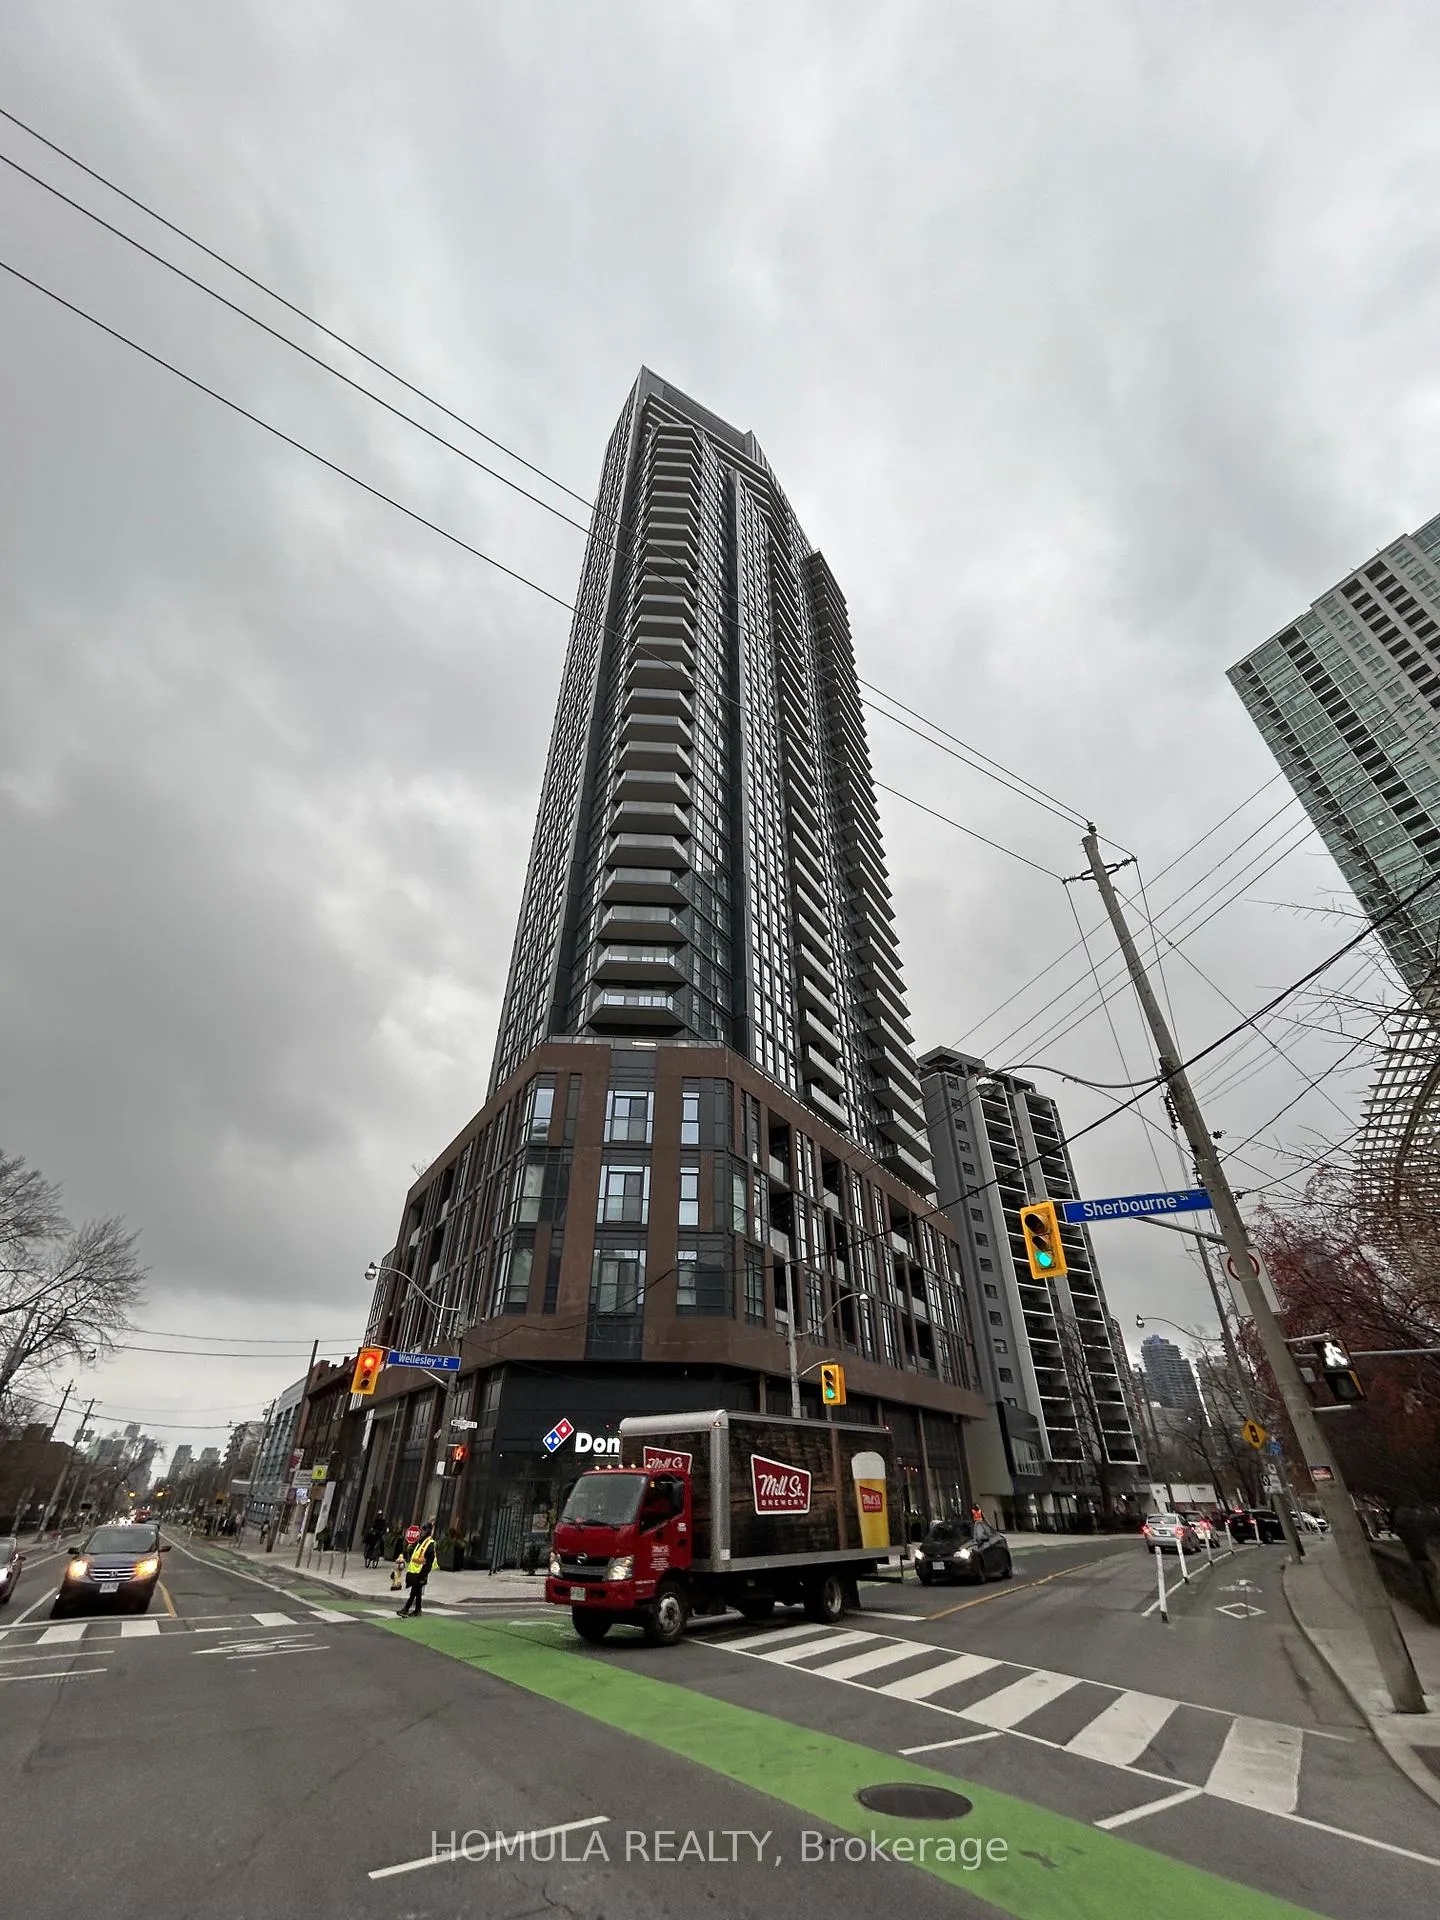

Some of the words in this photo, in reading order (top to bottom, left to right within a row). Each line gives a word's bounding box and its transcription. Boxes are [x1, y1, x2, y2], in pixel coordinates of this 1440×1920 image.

[1083, 1196, 1177, 1217] Sherbourne
[398, 1352, 437, 1368] Wellesley
[442, 1357, 449, 1367] E
[758, 1474, 788, 1496] Mill
[788, 1475, 805, 1498] St.
[407, 1530, 420, 1538] STOP
